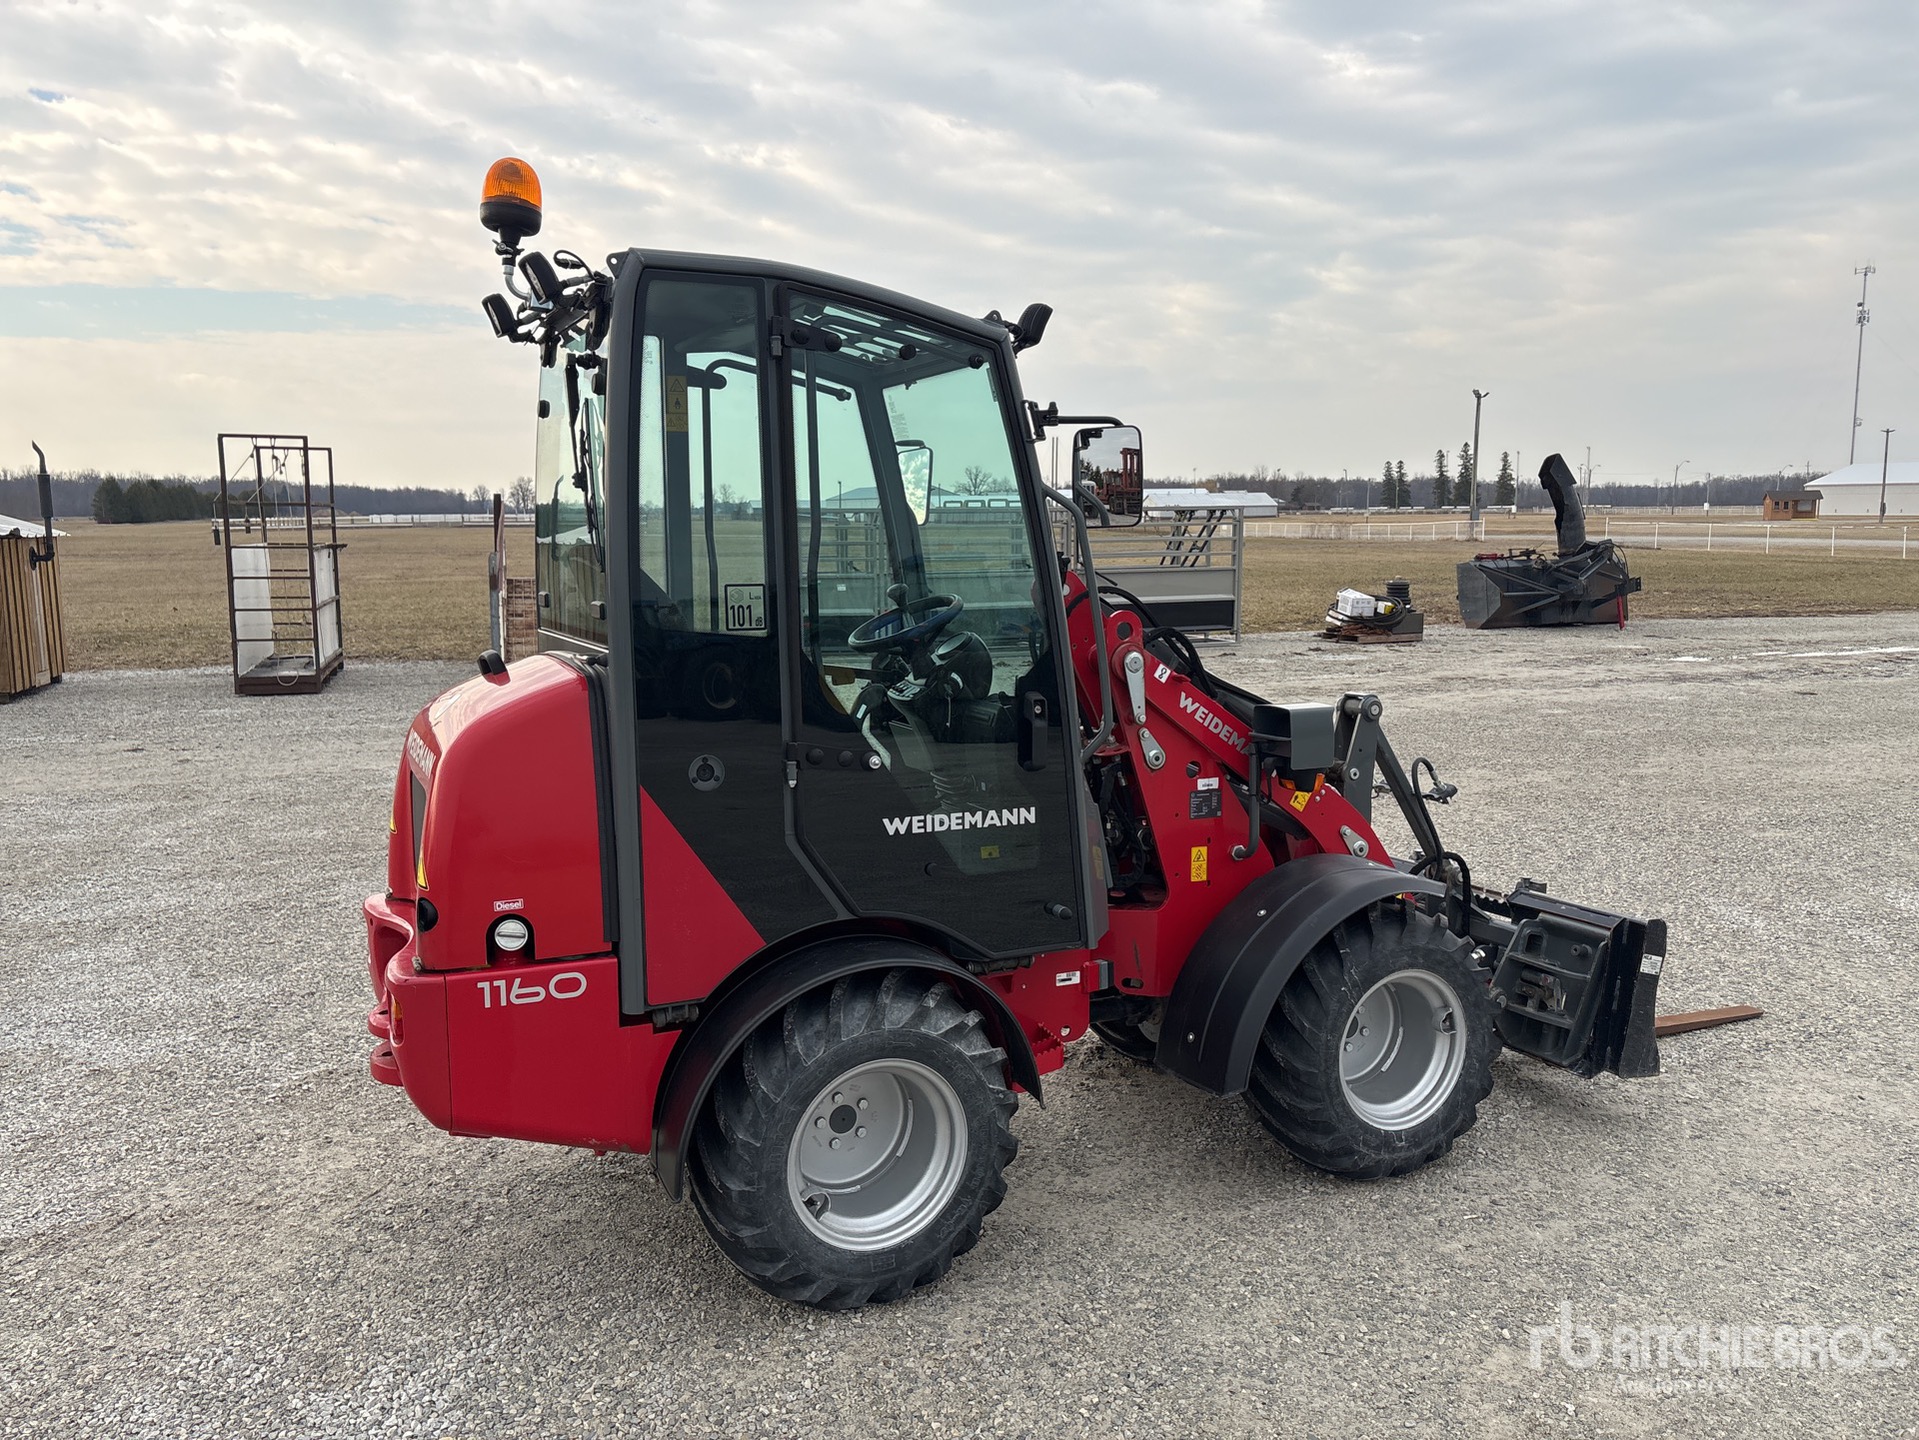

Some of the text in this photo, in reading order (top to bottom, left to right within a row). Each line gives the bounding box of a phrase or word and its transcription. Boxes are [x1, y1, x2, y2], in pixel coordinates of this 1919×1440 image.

[730, 604, 753, 627] 101
[882, 806, 1036, 836] WEIDEMANN
[495, 899, 522, 911] Diesel
[477, 971, 587, 1009] 1160
